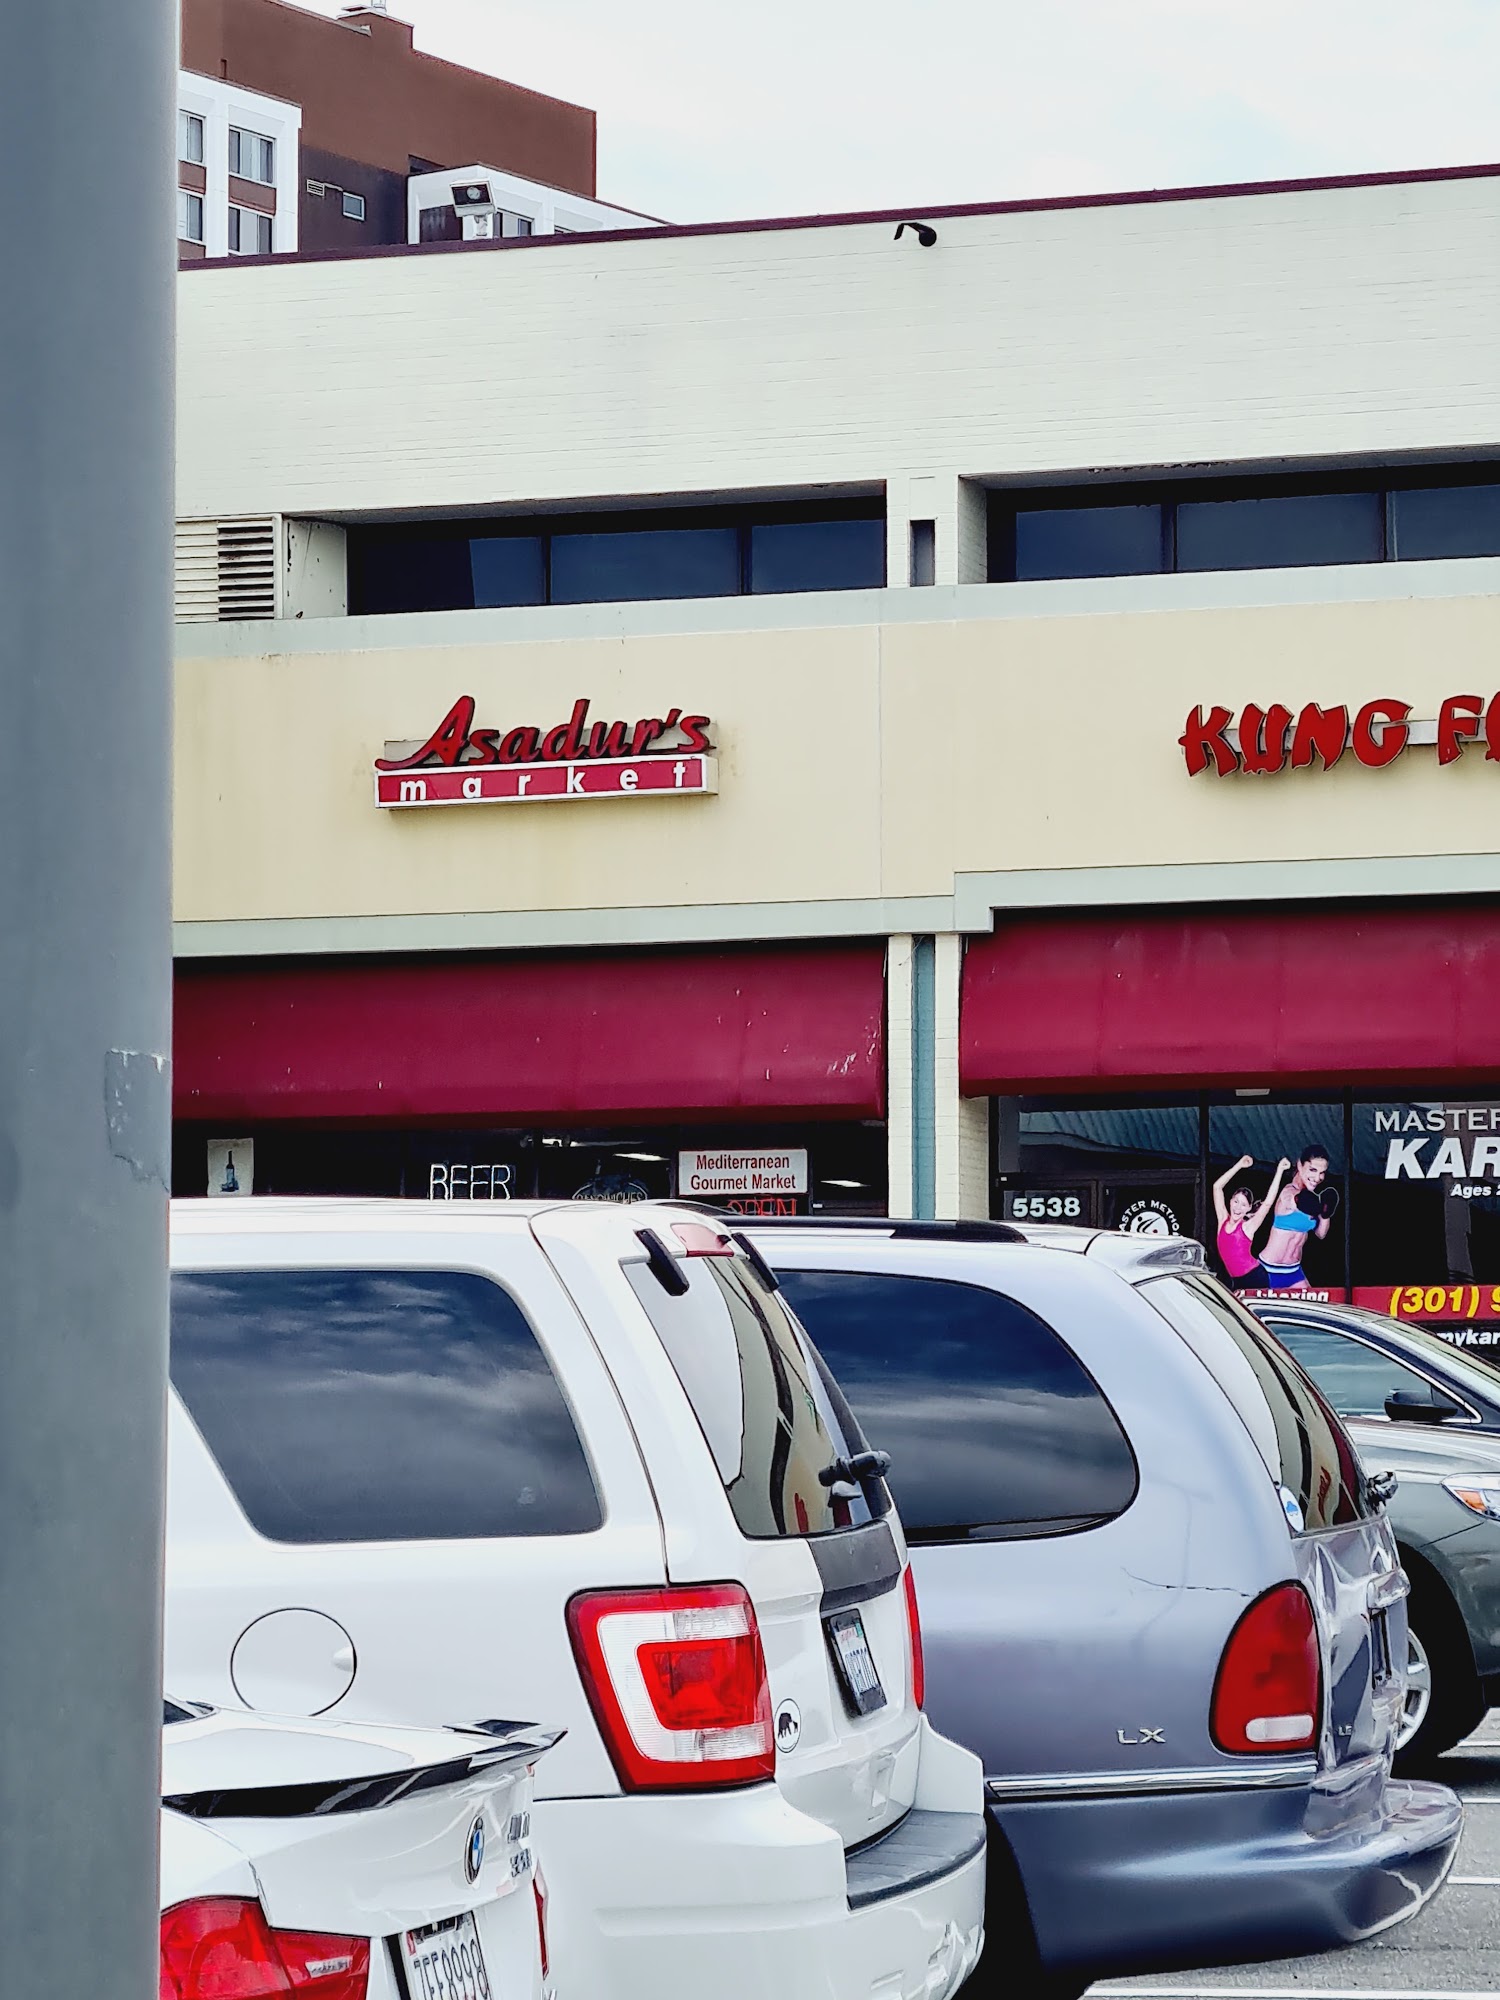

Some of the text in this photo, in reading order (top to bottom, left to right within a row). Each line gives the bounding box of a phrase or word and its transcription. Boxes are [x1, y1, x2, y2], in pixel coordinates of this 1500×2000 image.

[375, 695, 712, 771] Asadur's
[1178, 691, 1500, 777] KUNG F
[400, 762, 687, 802] market
[696, 1154, 790, 1171] Mediterranean
[690, 1173, 796, 1190] Gourmet Market
[1450, 1183, 1492, 1199] Ages
[1013, 1197, 1080, 1218] 5538
[1389, 1285, 1480, 1318] (301)
[1117, 1727, 1167, 1744] LX
